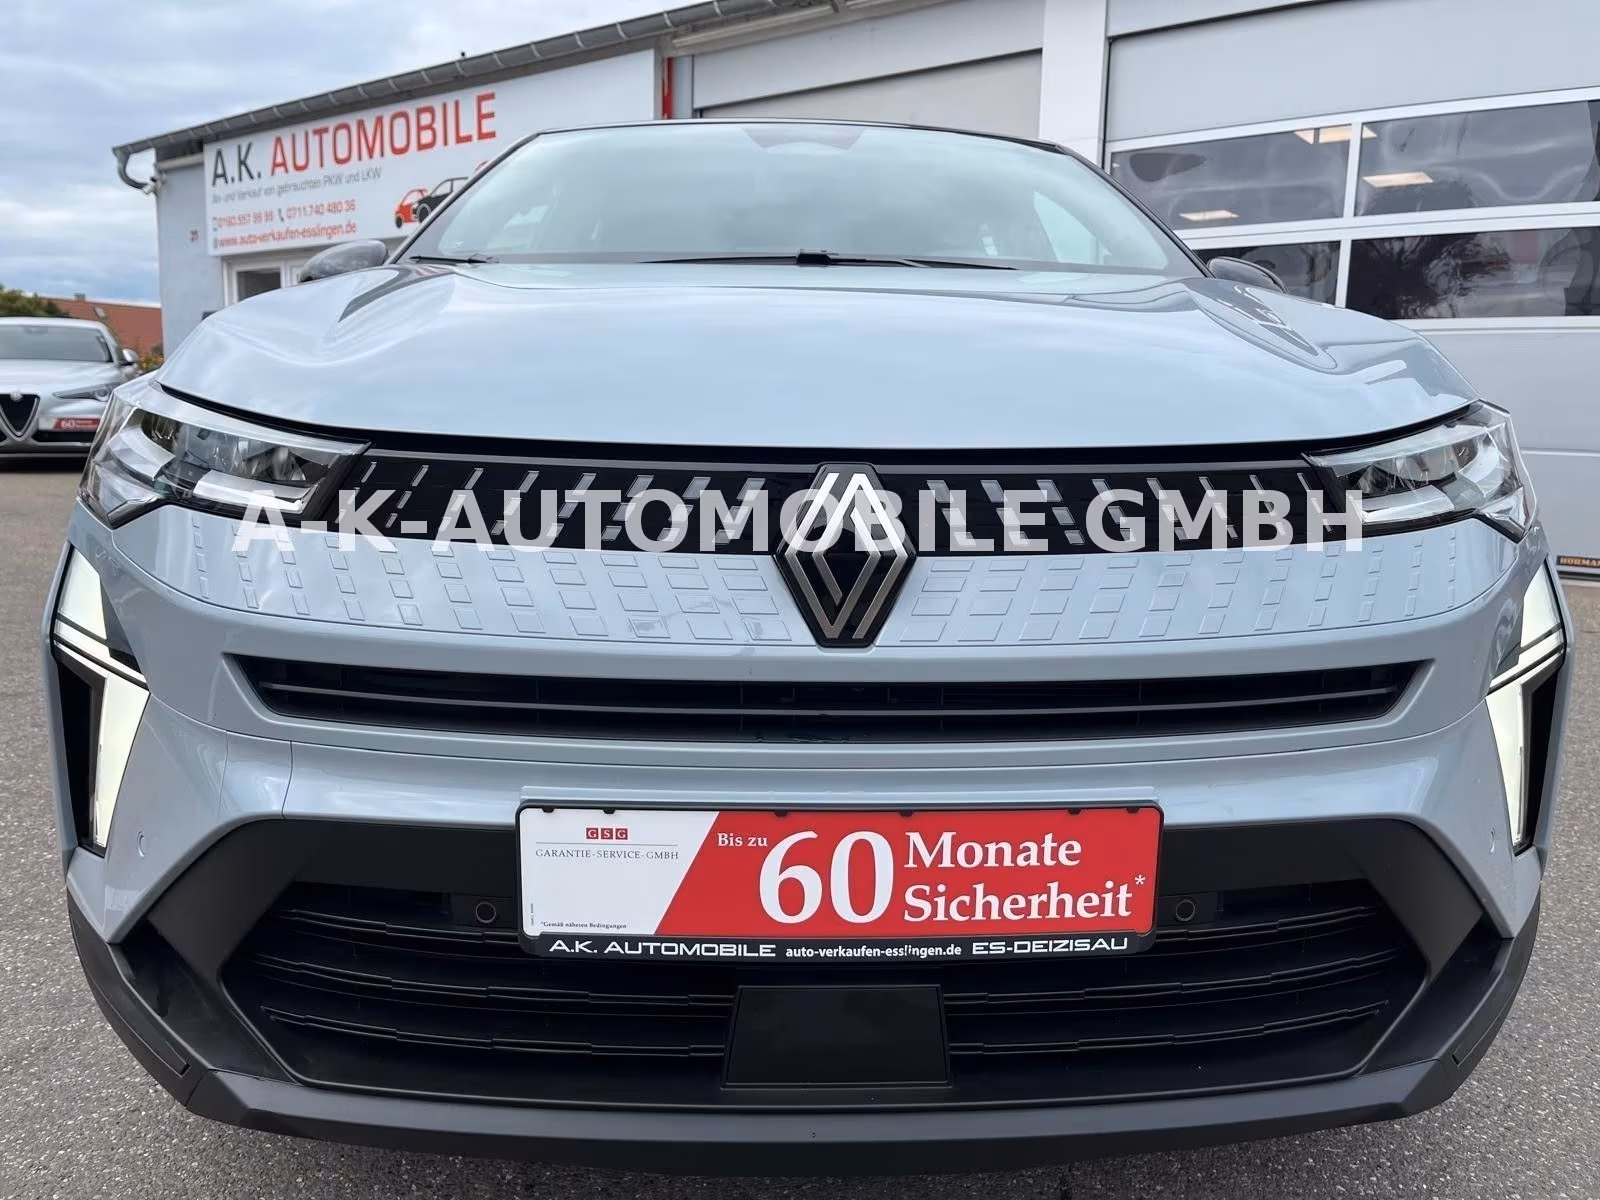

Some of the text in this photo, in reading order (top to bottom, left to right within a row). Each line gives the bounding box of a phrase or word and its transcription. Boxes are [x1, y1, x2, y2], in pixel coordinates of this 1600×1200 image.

[211, 91, 497, 186] A.K. AUTOMOBILE
[322, 174, 343, 185] PKW
[361, 167, 382, 181] LKW
[535, 848, 679, 860] GARANTIE-SERVICE-GMBH
[717, 830, 1082, 924] Bis zu 60 Monate
[549, 939, 598, 953] A.K.
[603, 941, 776, 957] AUTOMOBILE
[972, 937, 1128, 955] ES-DEIZISAU
